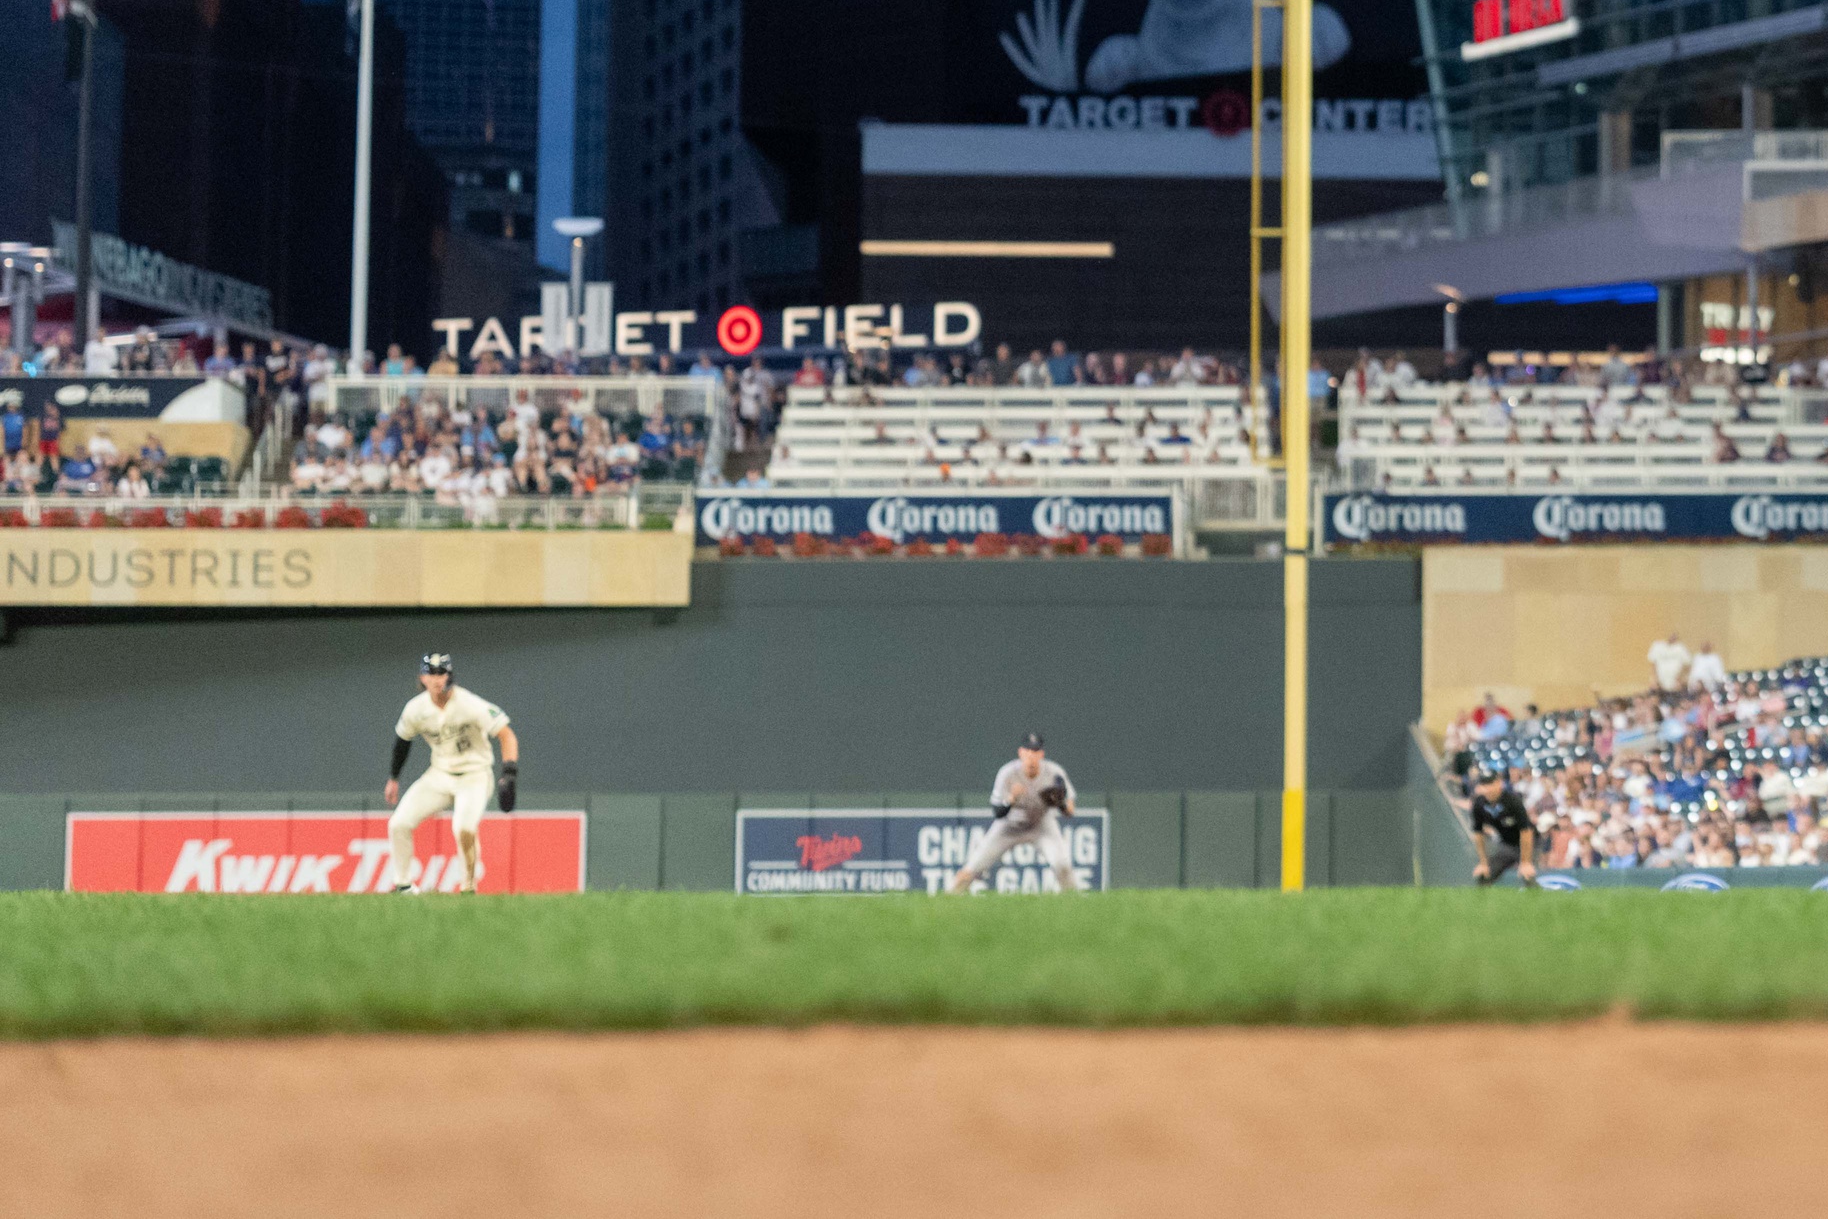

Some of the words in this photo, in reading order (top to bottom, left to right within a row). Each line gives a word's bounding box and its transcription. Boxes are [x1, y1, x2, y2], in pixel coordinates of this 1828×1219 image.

[1018, 95, 1199, 130] TARGET
[1254, 97, 1438, 134] CNTER
[782, 302, 982, 350] FIELD
[700, 497, 834, 540] Corona
[866, 496, 998, 542] Corona
[1031, 495, 1165, 539] Corona
[1332, 494, 1467, 540] Corona
[1532, 495, 1666, 541] Corona
